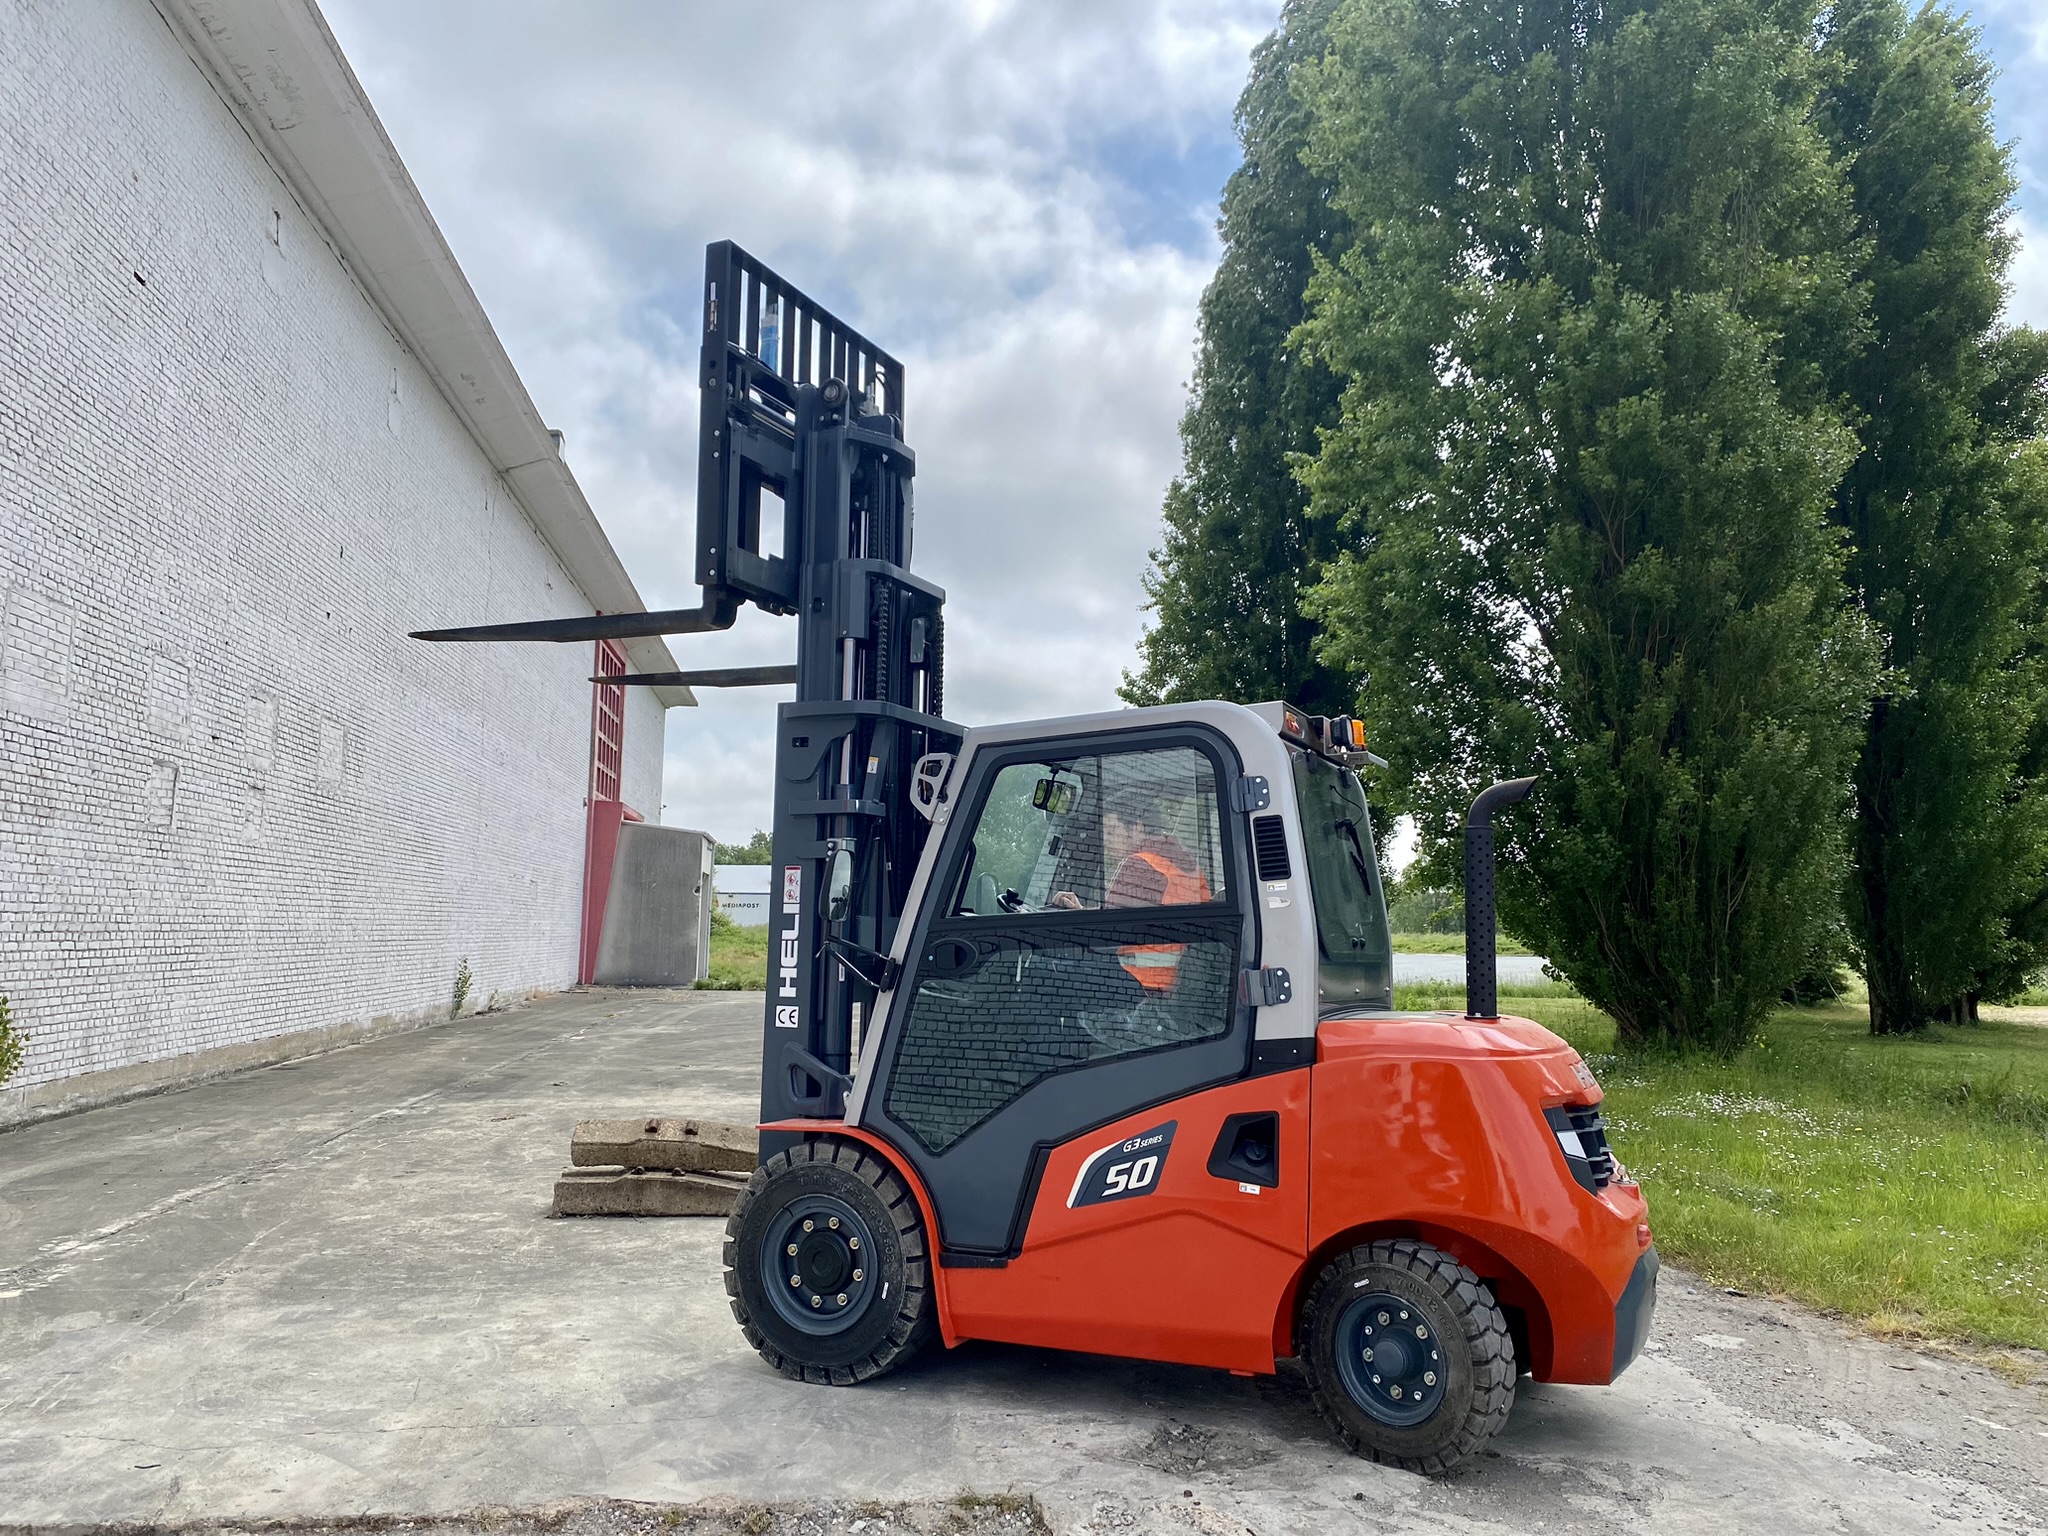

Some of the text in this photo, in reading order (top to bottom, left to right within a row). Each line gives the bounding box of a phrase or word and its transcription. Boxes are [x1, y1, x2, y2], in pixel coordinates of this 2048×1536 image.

[779, 903, 800, 998] HELI
[1123, 1135, 1163, 1153] G3 SERIES
[1101, 1155, 1159, 1197] 50
